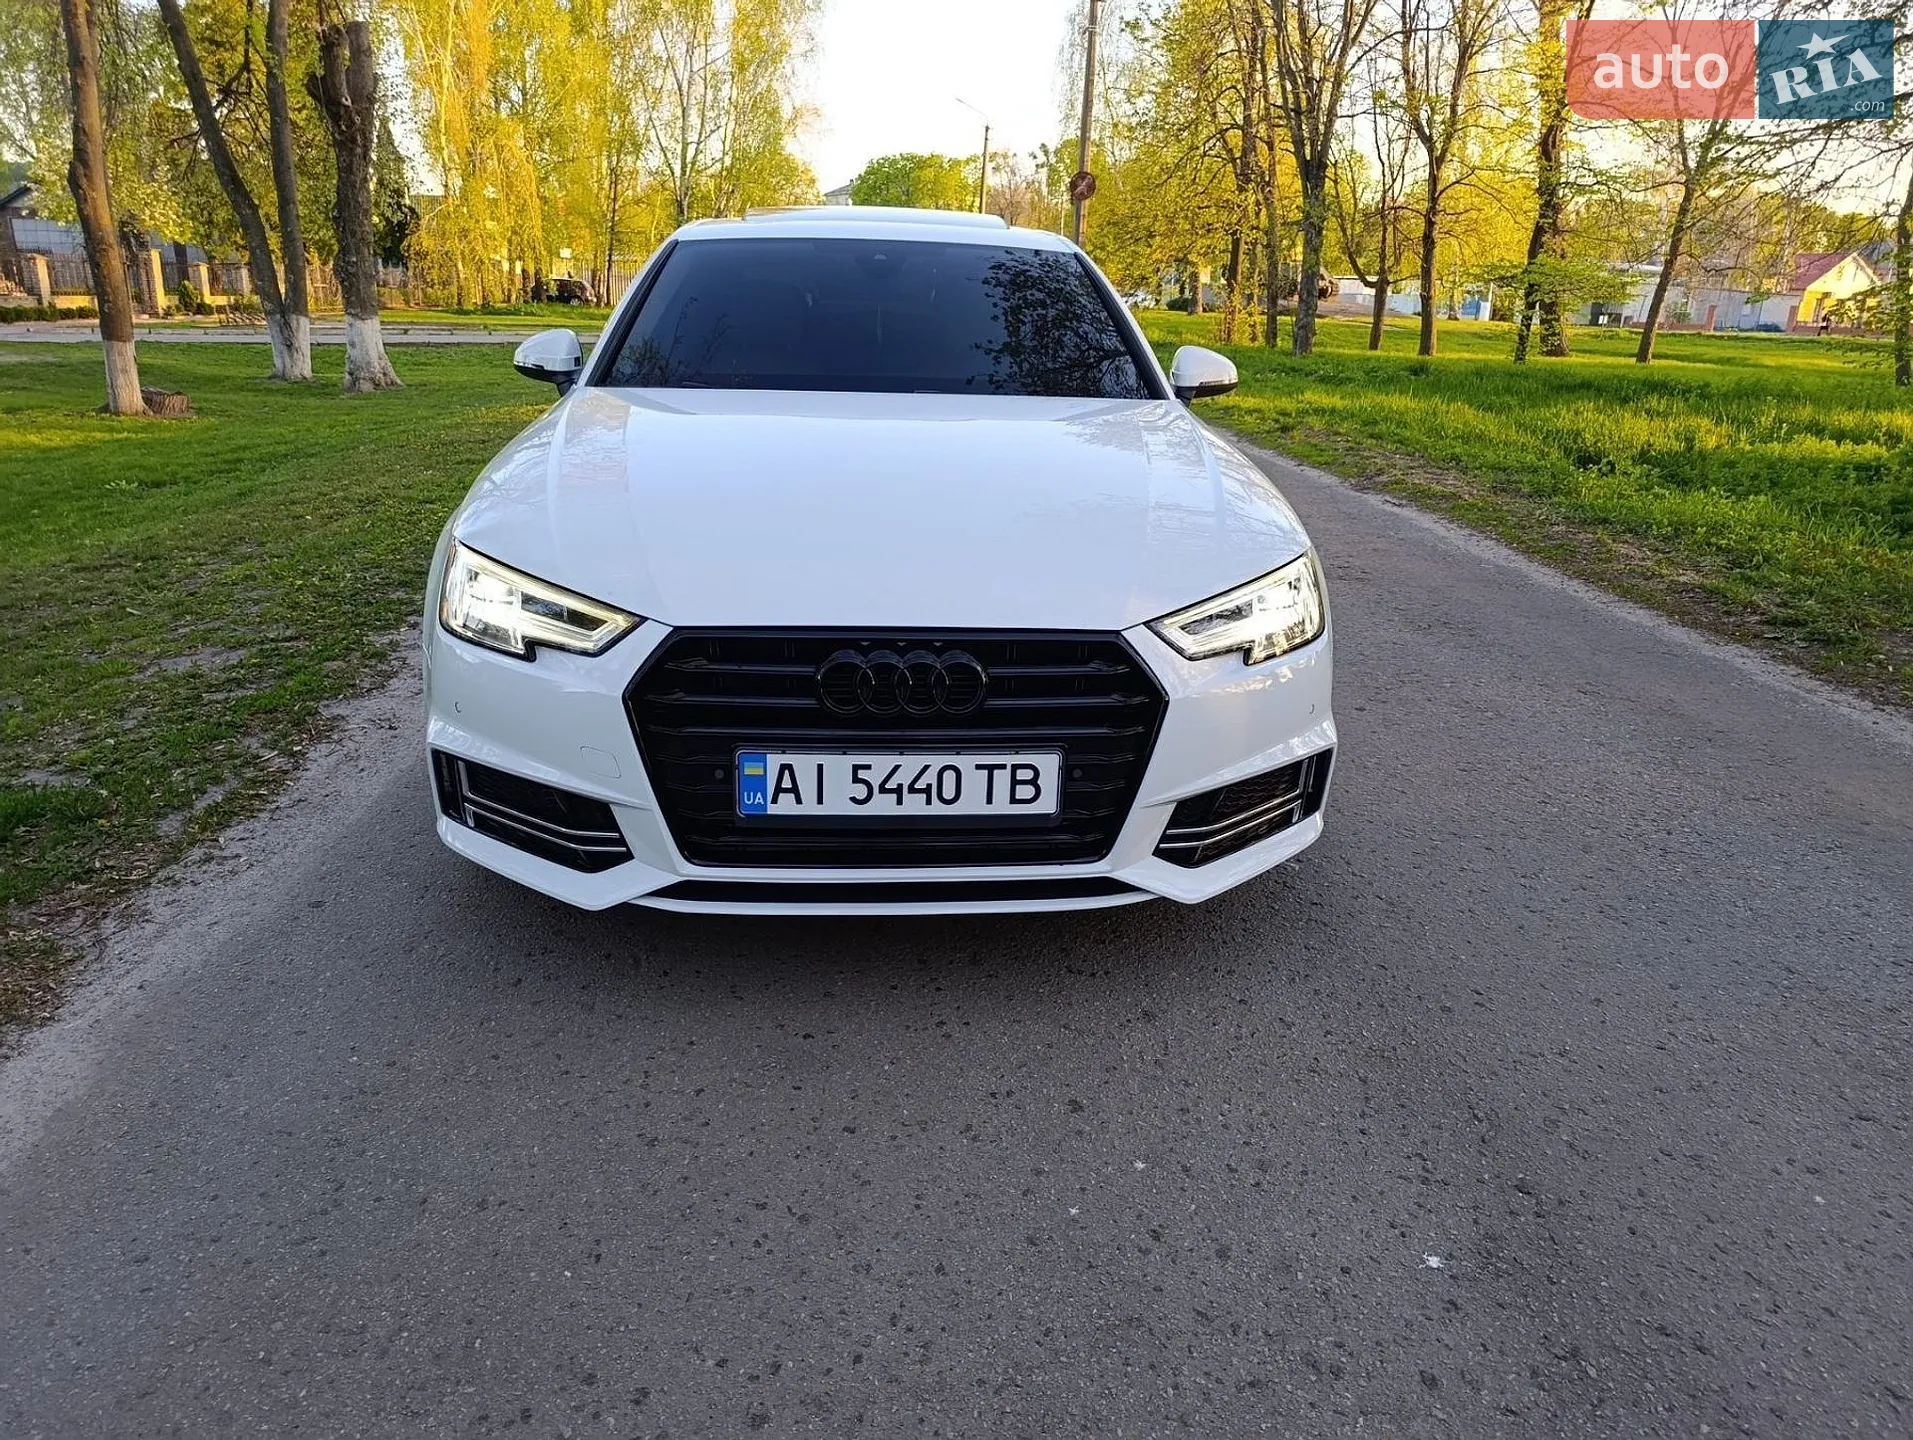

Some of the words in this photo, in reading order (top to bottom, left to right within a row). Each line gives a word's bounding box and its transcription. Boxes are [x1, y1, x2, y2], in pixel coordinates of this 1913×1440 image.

[743, 791, 765, 806] UA
[770, 762, 825, 806] AI
[848, 762, 963, 807] 5440
[974, 762, 1043, 806] TB
